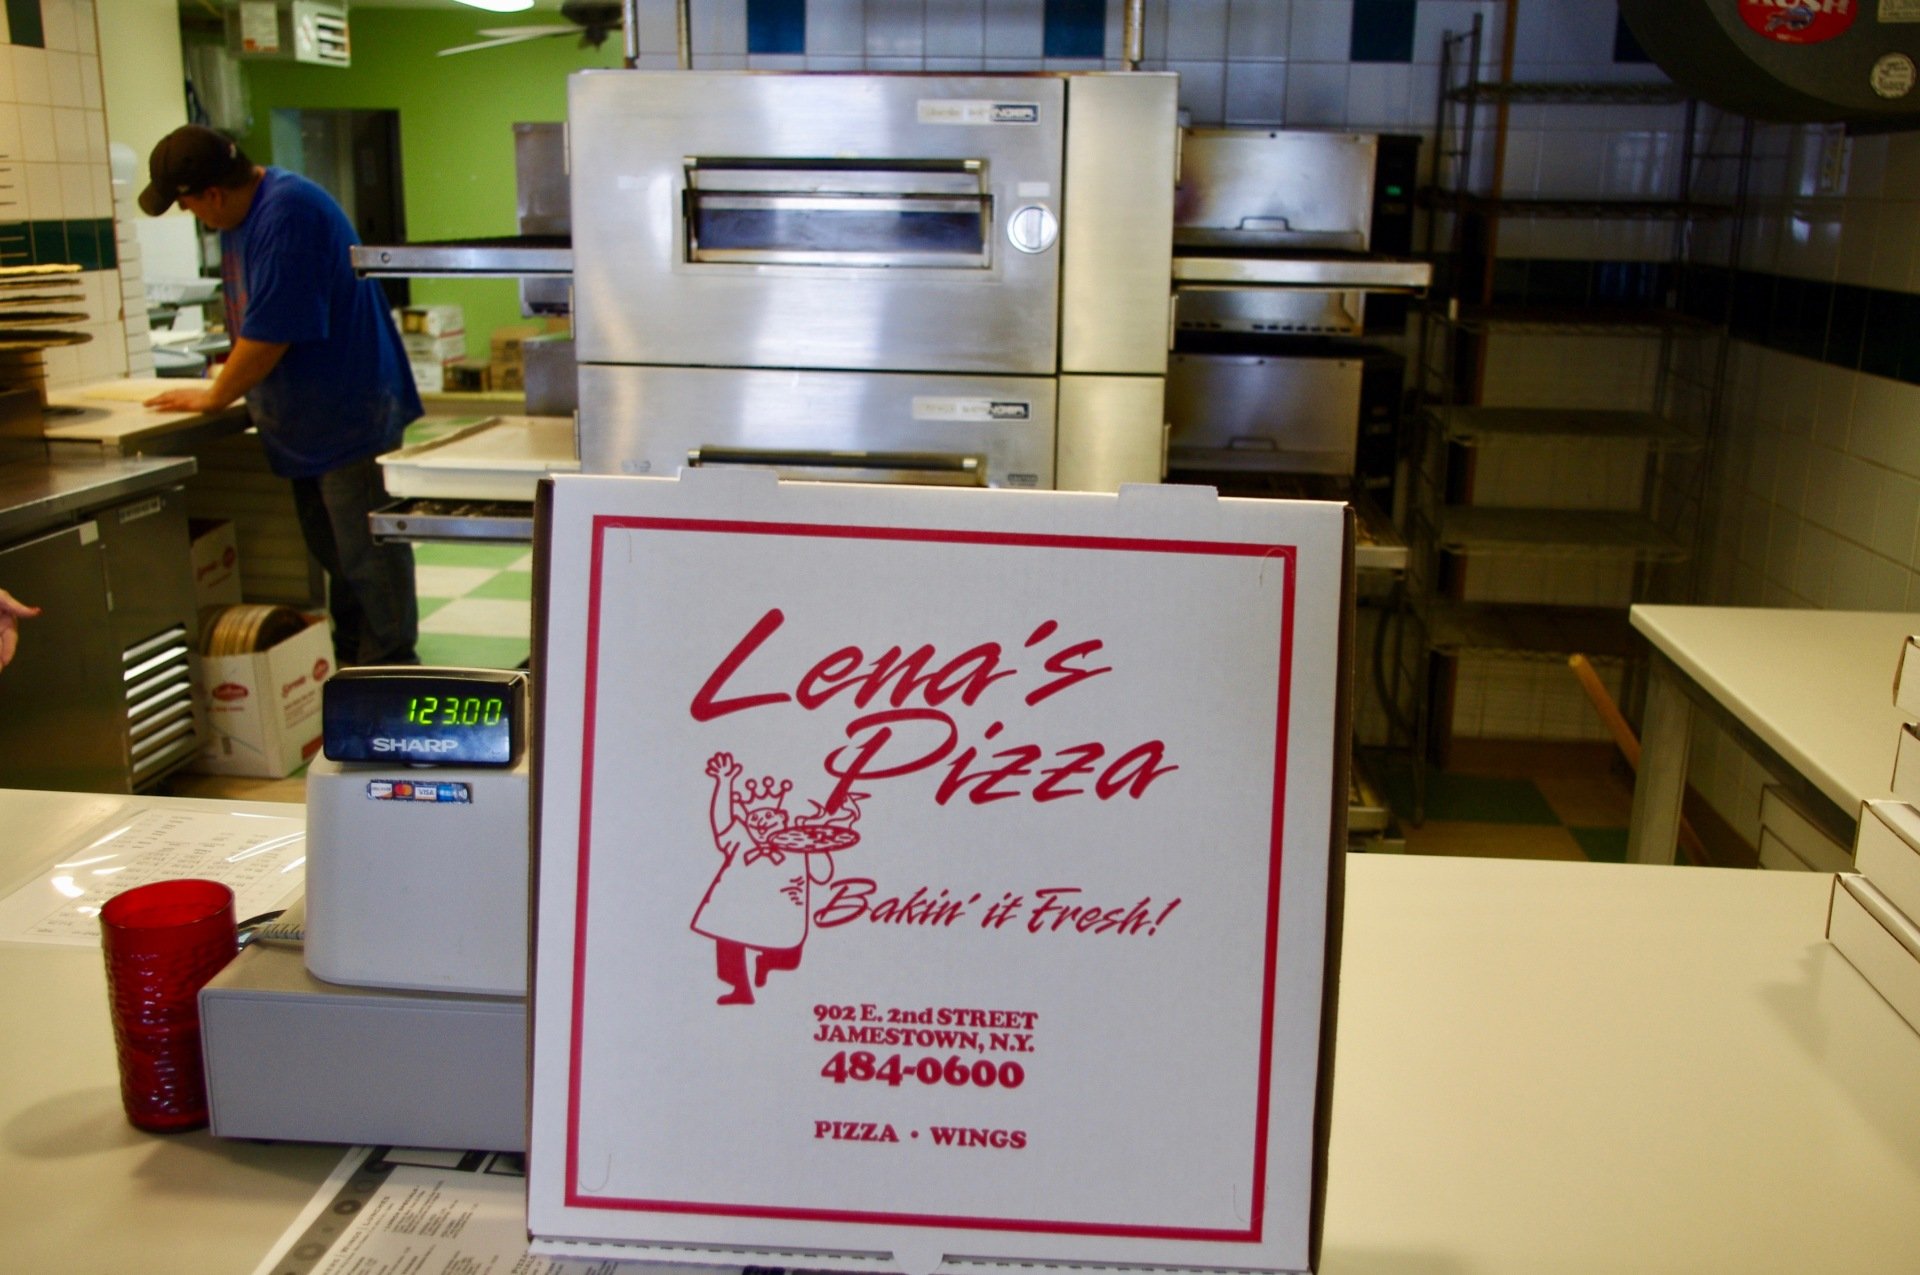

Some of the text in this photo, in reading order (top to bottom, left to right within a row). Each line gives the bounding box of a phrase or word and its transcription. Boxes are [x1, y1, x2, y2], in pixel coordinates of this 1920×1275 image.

[689, 607, 1112, 723] Lena's
[407, 697, 502, 727] 123.00
[373, 737, 459, 753] SHARP
[824, 707, 1179, 816] Pizza
[813, 877, 1182, 936] Bakin' it Fresh!
[813, 1004, 1039, 1031] 902 E. 2nd STREET
[813, 1024, 1035, 1053] JAMESTOWN, N.Y.
[820, 1050, 1026, 1089] 484-0600
[814, 1121, 1028, 1150] PIZZA WINGS
